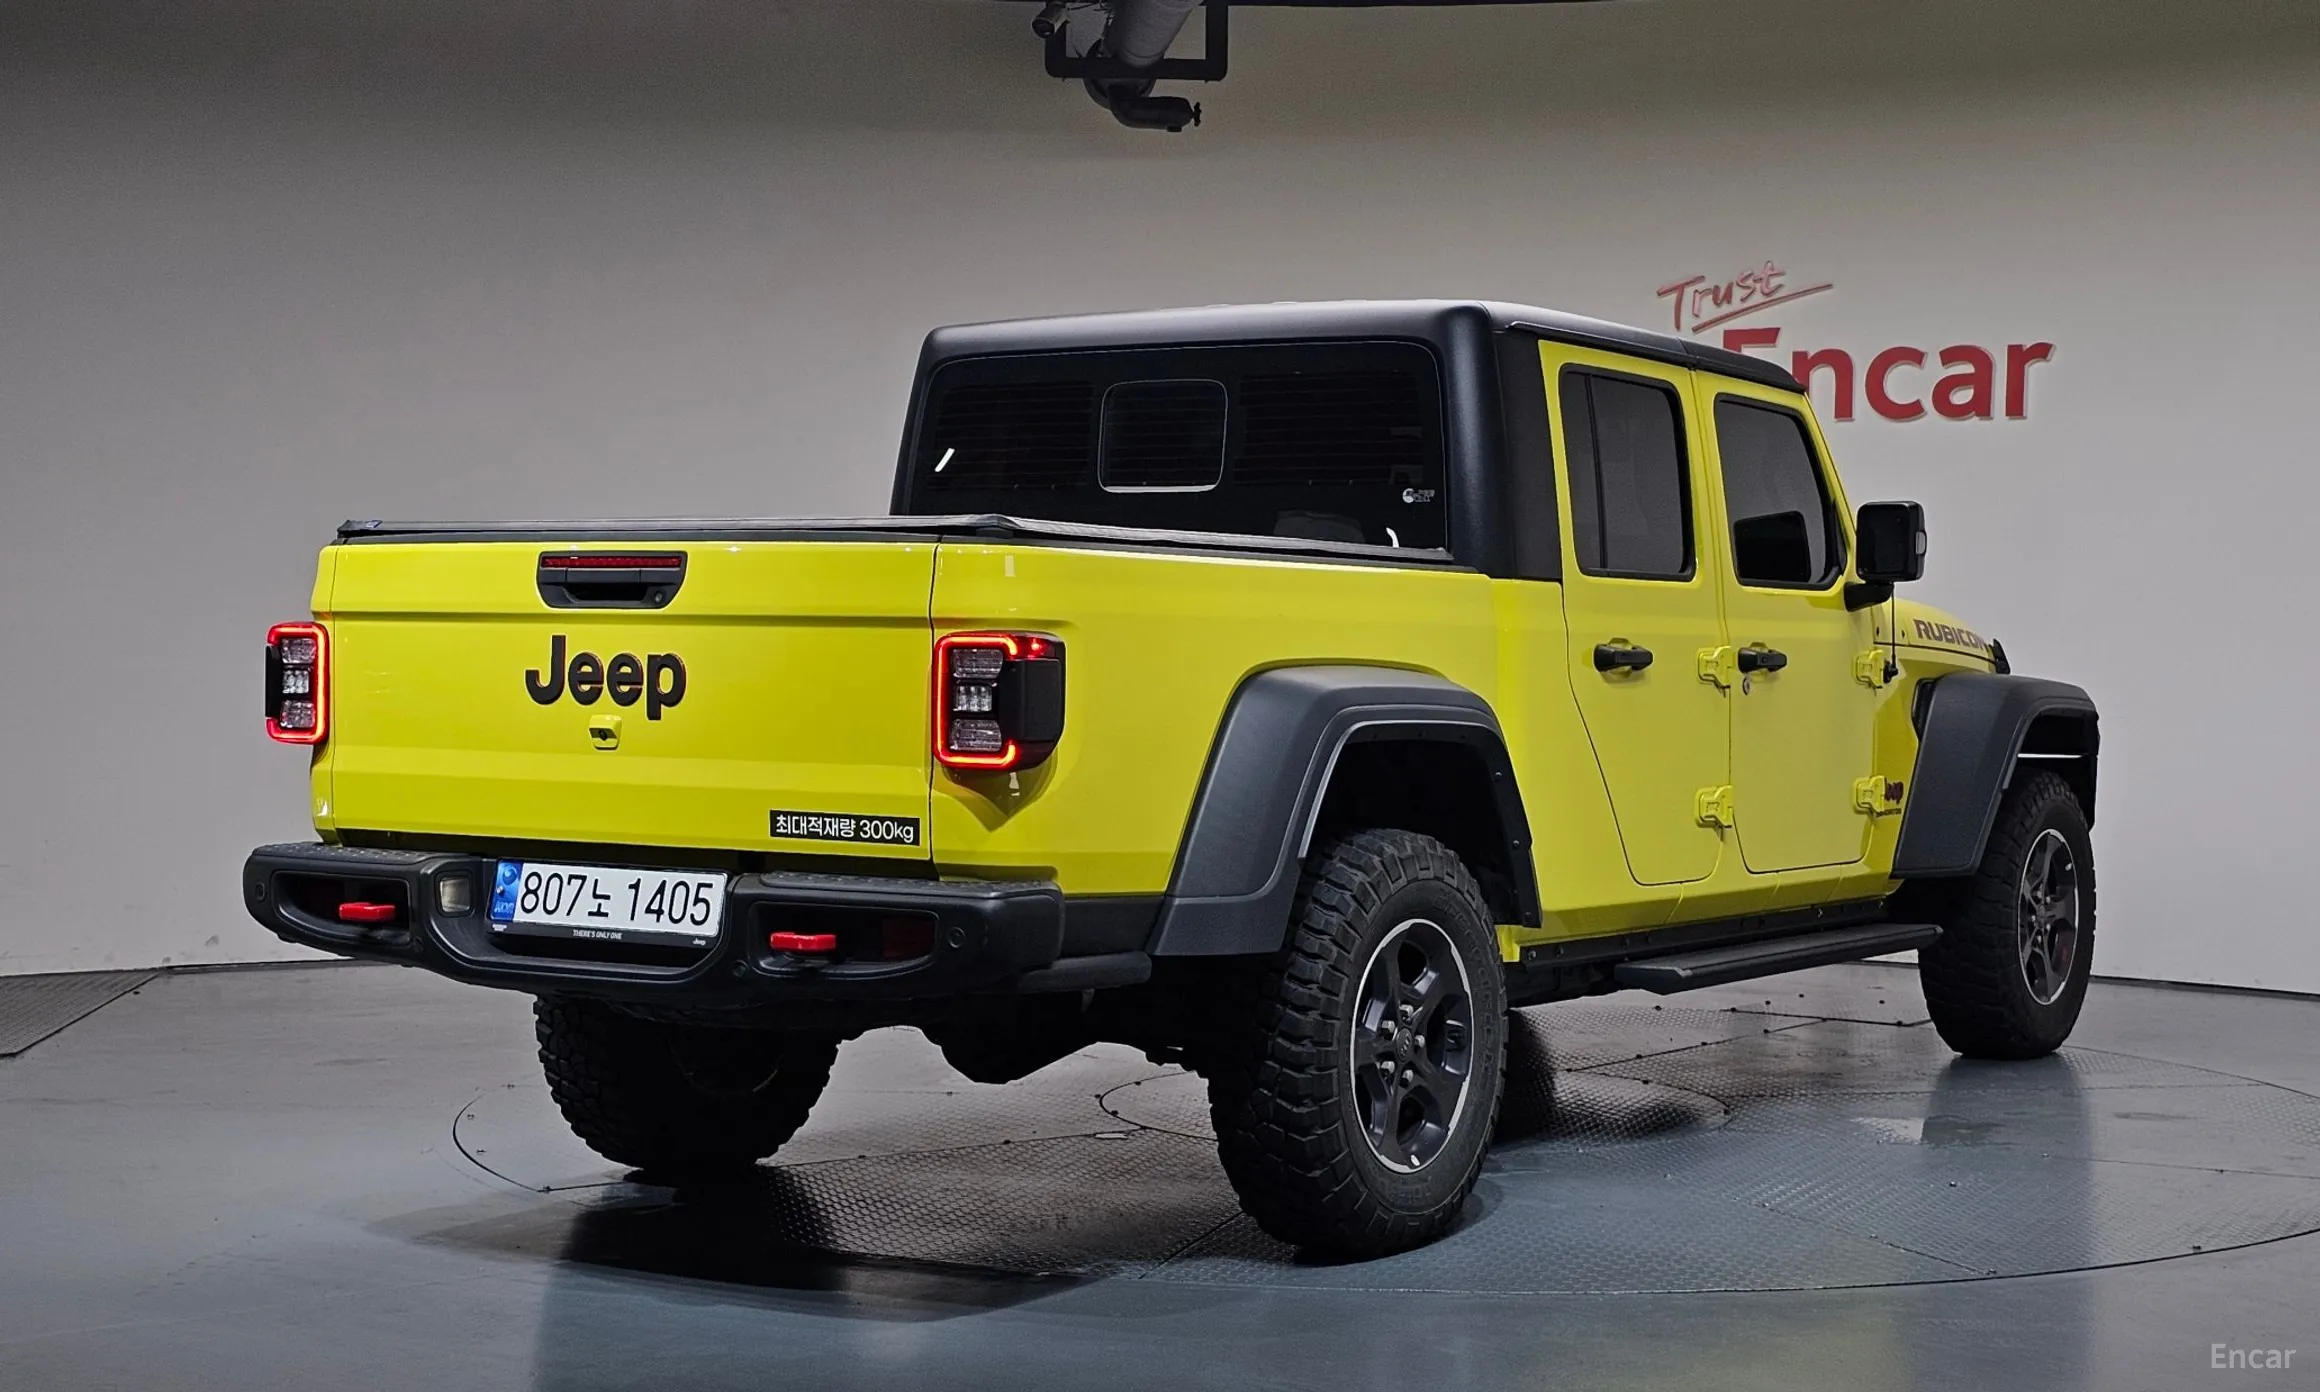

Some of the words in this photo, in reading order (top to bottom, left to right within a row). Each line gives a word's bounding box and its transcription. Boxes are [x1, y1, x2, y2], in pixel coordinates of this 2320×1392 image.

[1656, 260, 1787, 332] Trust
[524, 634, 687, 721] Jeep
[775, 814, 857, 838] 최대적재량
[859, 819, 915, 843] 300kg
[520, 871, 612, 917] 807노
[627, 878, 714, 926] 1405
